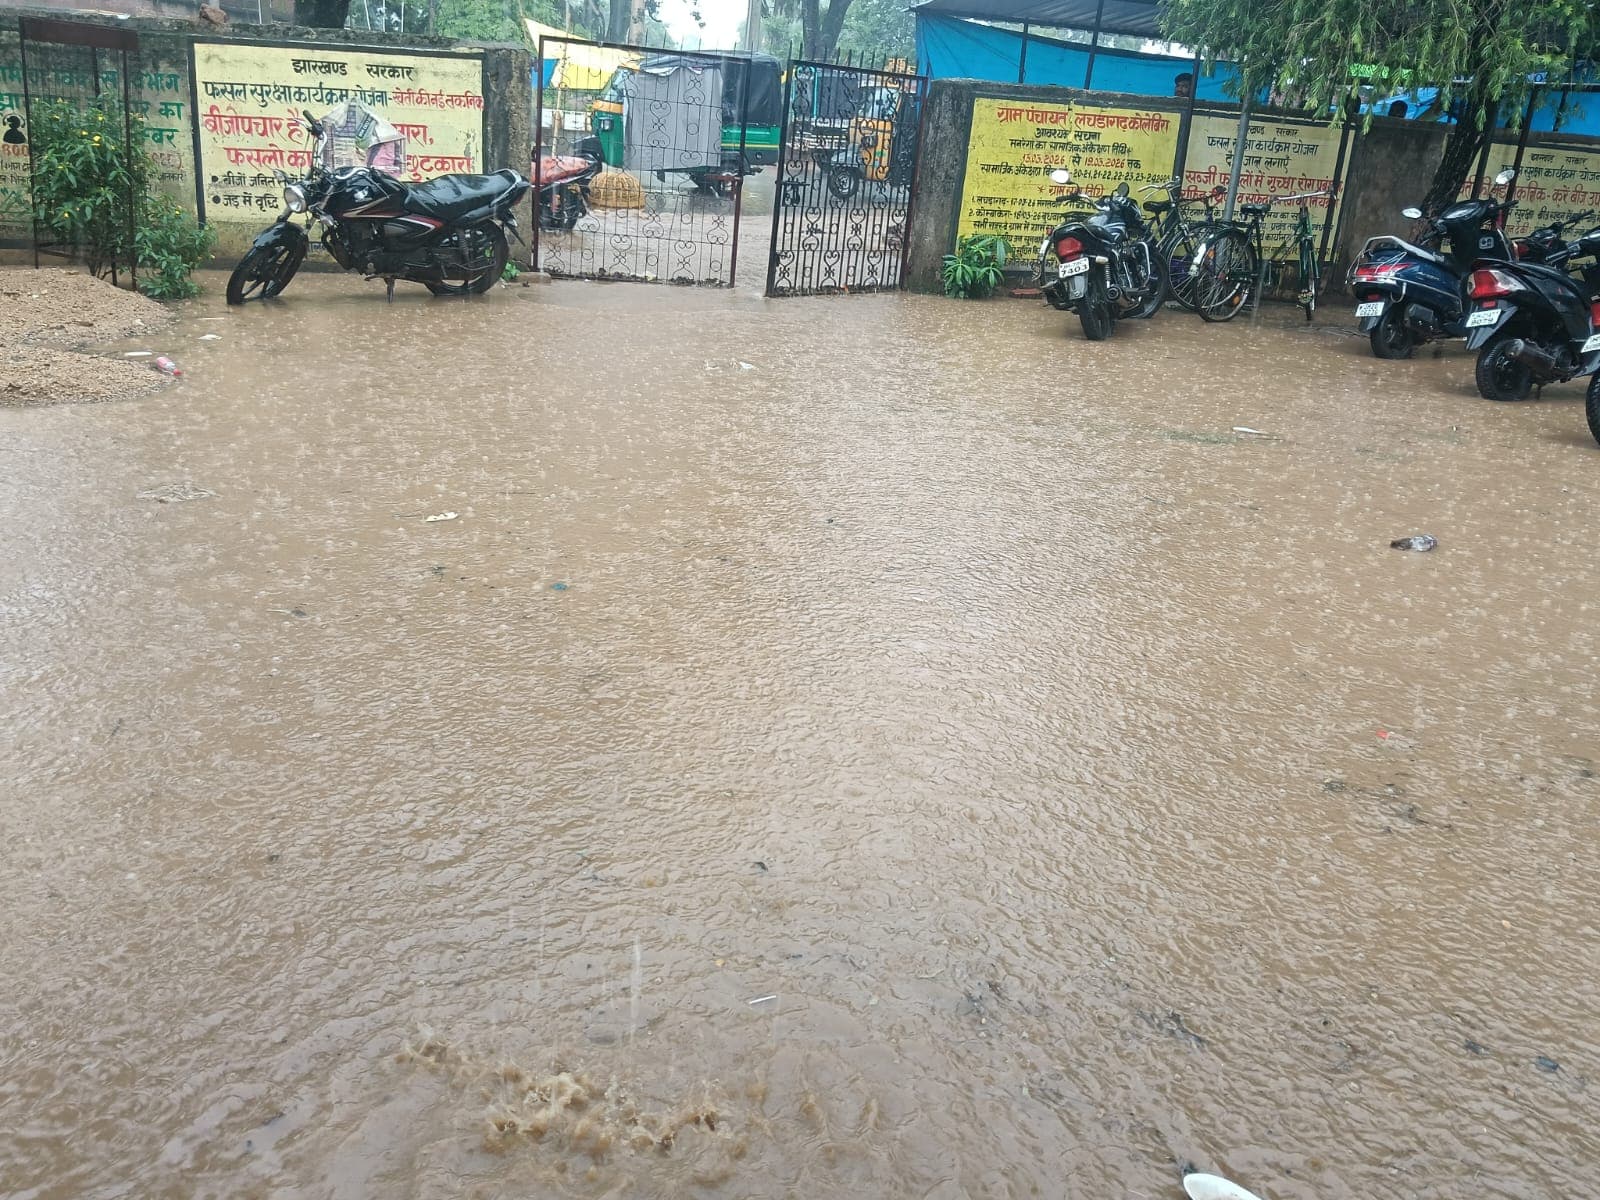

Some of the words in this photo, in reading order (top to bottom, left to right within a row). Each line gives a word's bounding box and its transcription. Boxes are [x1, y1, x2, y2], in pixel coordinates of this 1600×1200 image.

[291, 58, 348, 76] झारखण्ड
[365, 64, 415, 82] सरकार
[202, 81, 249, 101] फसल
[249, 83, 293, 108] सुरक्षा
[158, 101, 185, 121] का
[996, 106, 1025, 125] ग्राम
[1025, 106, 1069, 130] पंचायत
[202, 105, 287, 142] बीजोपचार
